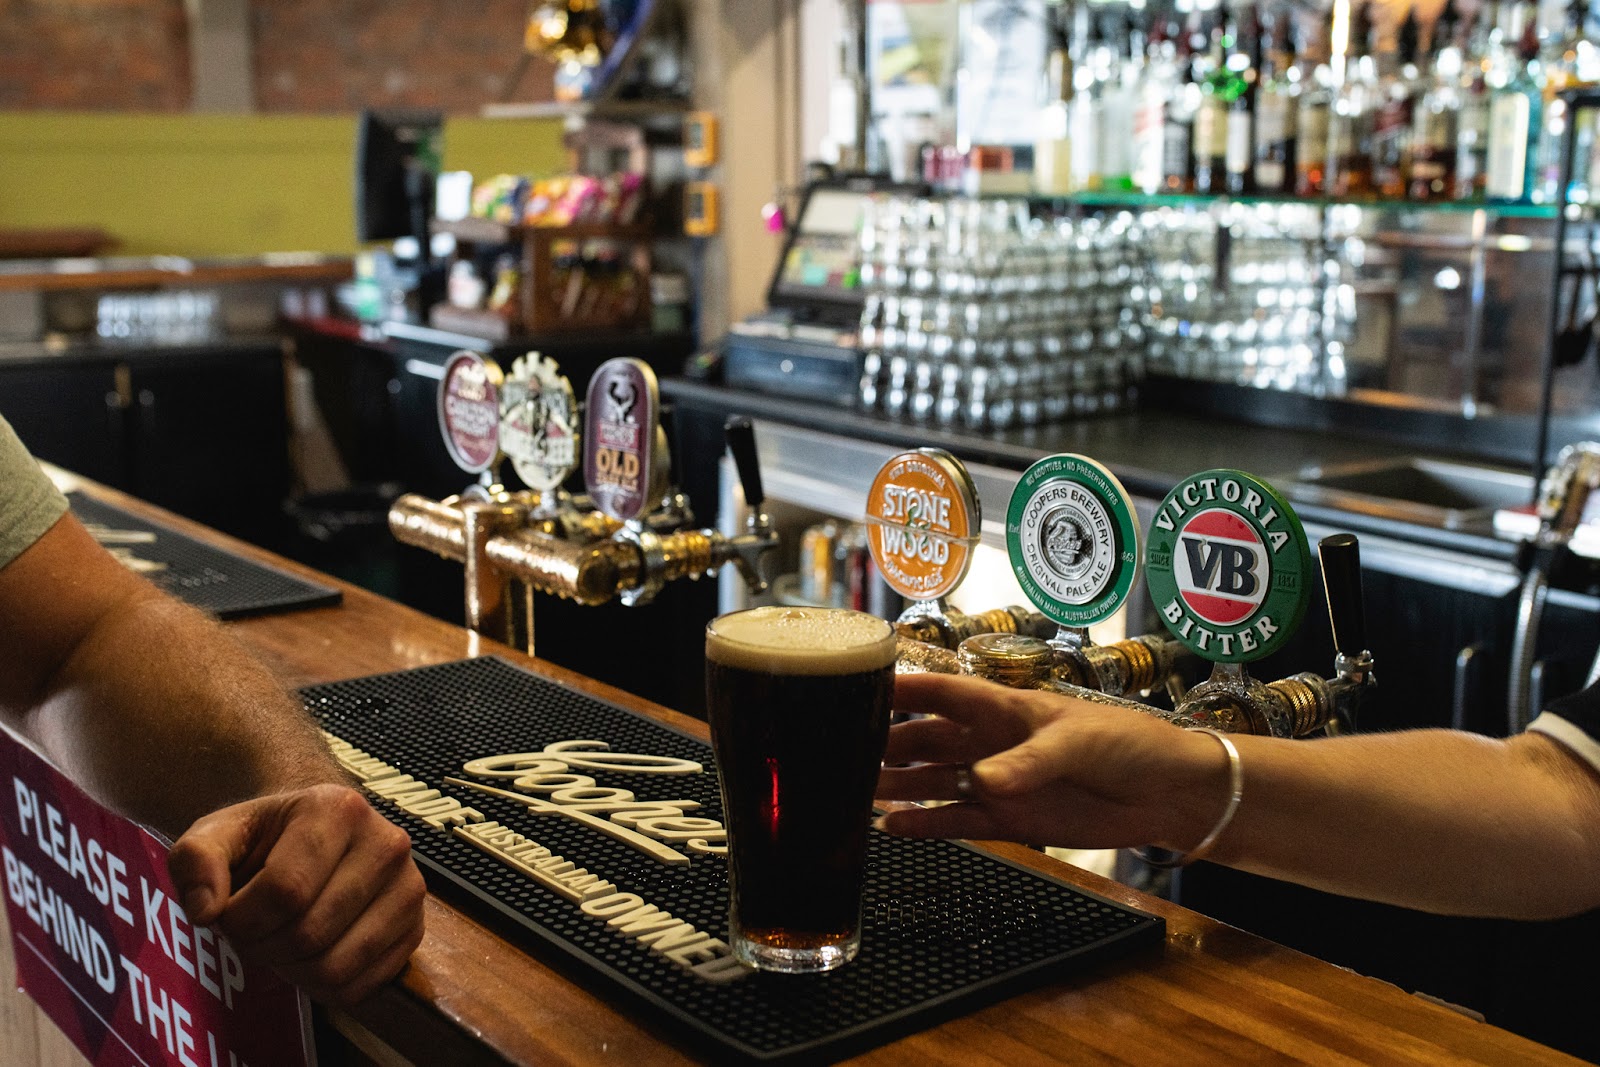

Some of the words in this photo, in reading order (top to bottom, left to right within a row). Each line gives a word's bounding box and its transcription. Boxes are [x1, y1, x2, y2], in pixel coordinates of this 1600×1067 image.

[596, 447, 640, 480] OLD
[1034, 460, 1063, 480] ADDITIVES
[1066, 461, 1076, 472] NO
[1076, 463, 1119, 506] PRESERVATIVES
[882, 483, 951, 530] STONE
[1027, 487, 1068, 529] COOPERS
[1070, 490, 1111, 548] BREWERY
[1156, 478, 1289, 554] VICTORIA
[884, 524, 949, 566] WOOD
[1027, 542, 1063, 595] ORIGINAL
[1066, 581, 1092, 597] PALE
[1093, 561, 1108, 585] ALE
[1150, 552, 1170, 567] SINCE
[1181, 537, 1258, 598] VB
[1017, 566, 1045, 606] AUSTRALIAN
[1044, 600, 1060, 617] MADE
[1064, 609, 1101, 622] AUSTRALIAN
[1100, 591, 1119, 613] OWNED
[1163, 598, 1279, 656] BITTER
[362, 774, 485, 832] MADE
[463, 820, 618, 902] AUSTRALIAN
[13, 775, 135, 927] PLEASE
[139, 875, 246, 1011] KEEP
[2, 845, 117, 994] BEHIND
[119, 953, 198, 1067] THE
